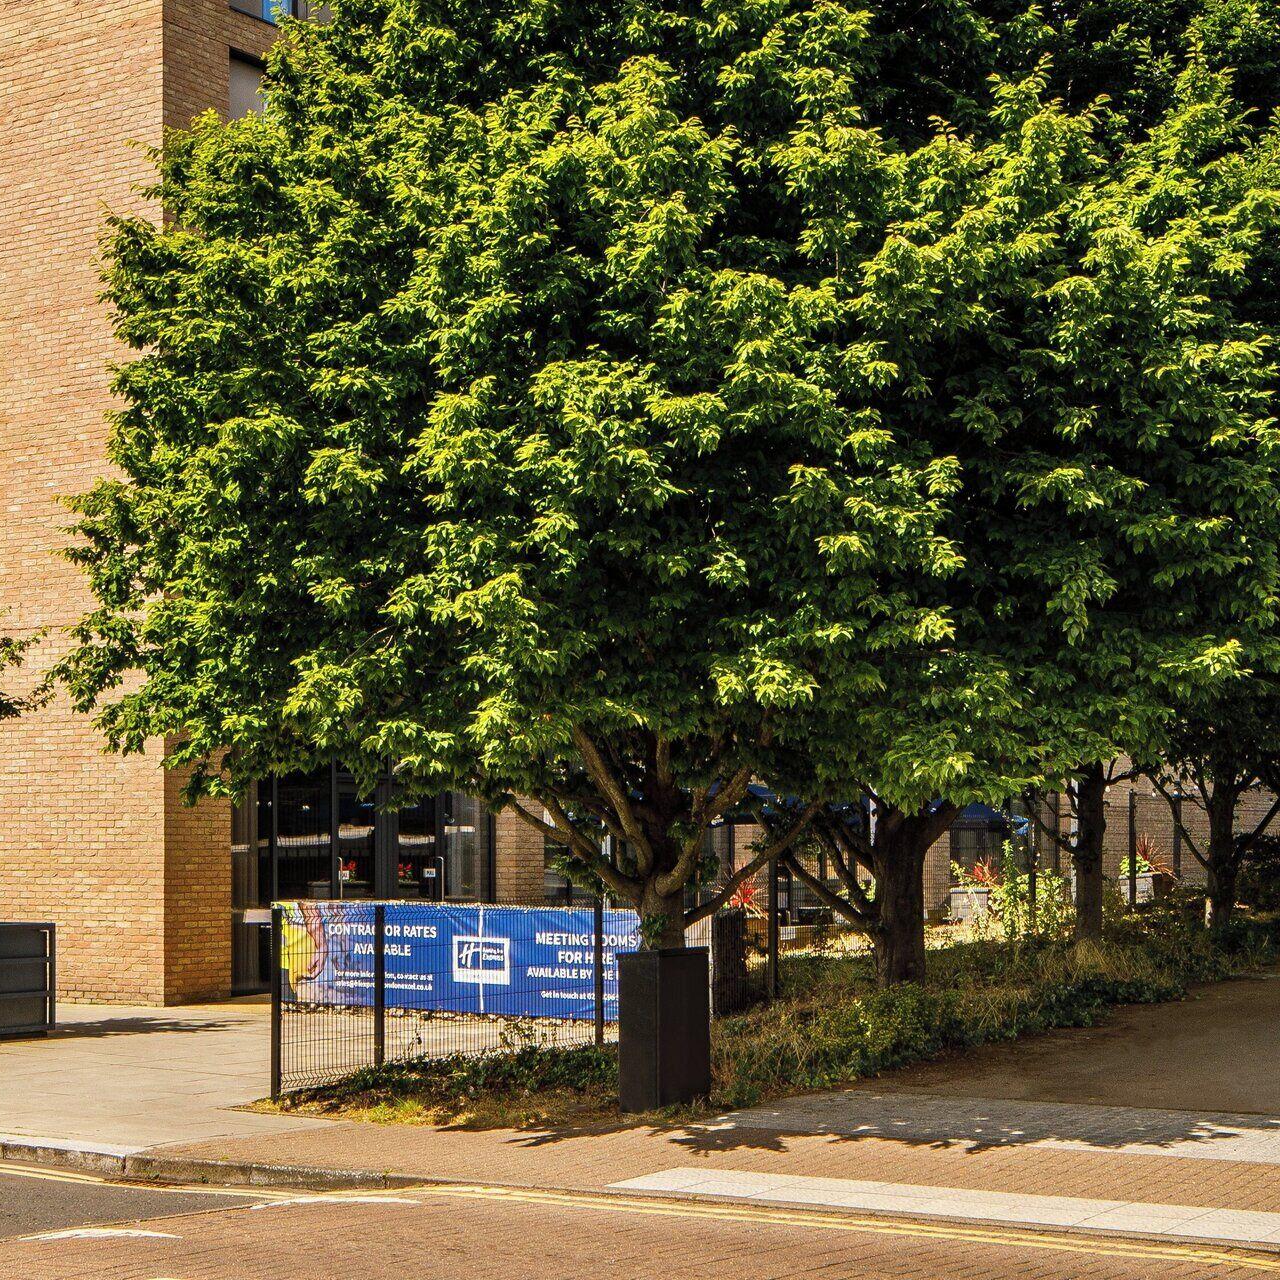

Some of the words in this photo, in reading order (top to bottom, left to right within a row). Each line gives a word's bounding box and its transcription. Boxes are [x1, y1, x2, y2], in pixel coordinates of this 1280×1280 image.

[403, 925, 437, 939] RATES
[535, 932, 589, 946] MEETING
[353, 943, 412, 957] AVAABLE
[558, 951, 582, 964] FOR
[584, 951, 614, 965] HRE
[527, 967, 578, 980] AVAILABLE
[579, 968, 592, 980] BY
[540, 990, 553, 999] Get
[559, 991, 579, 1000] touch
